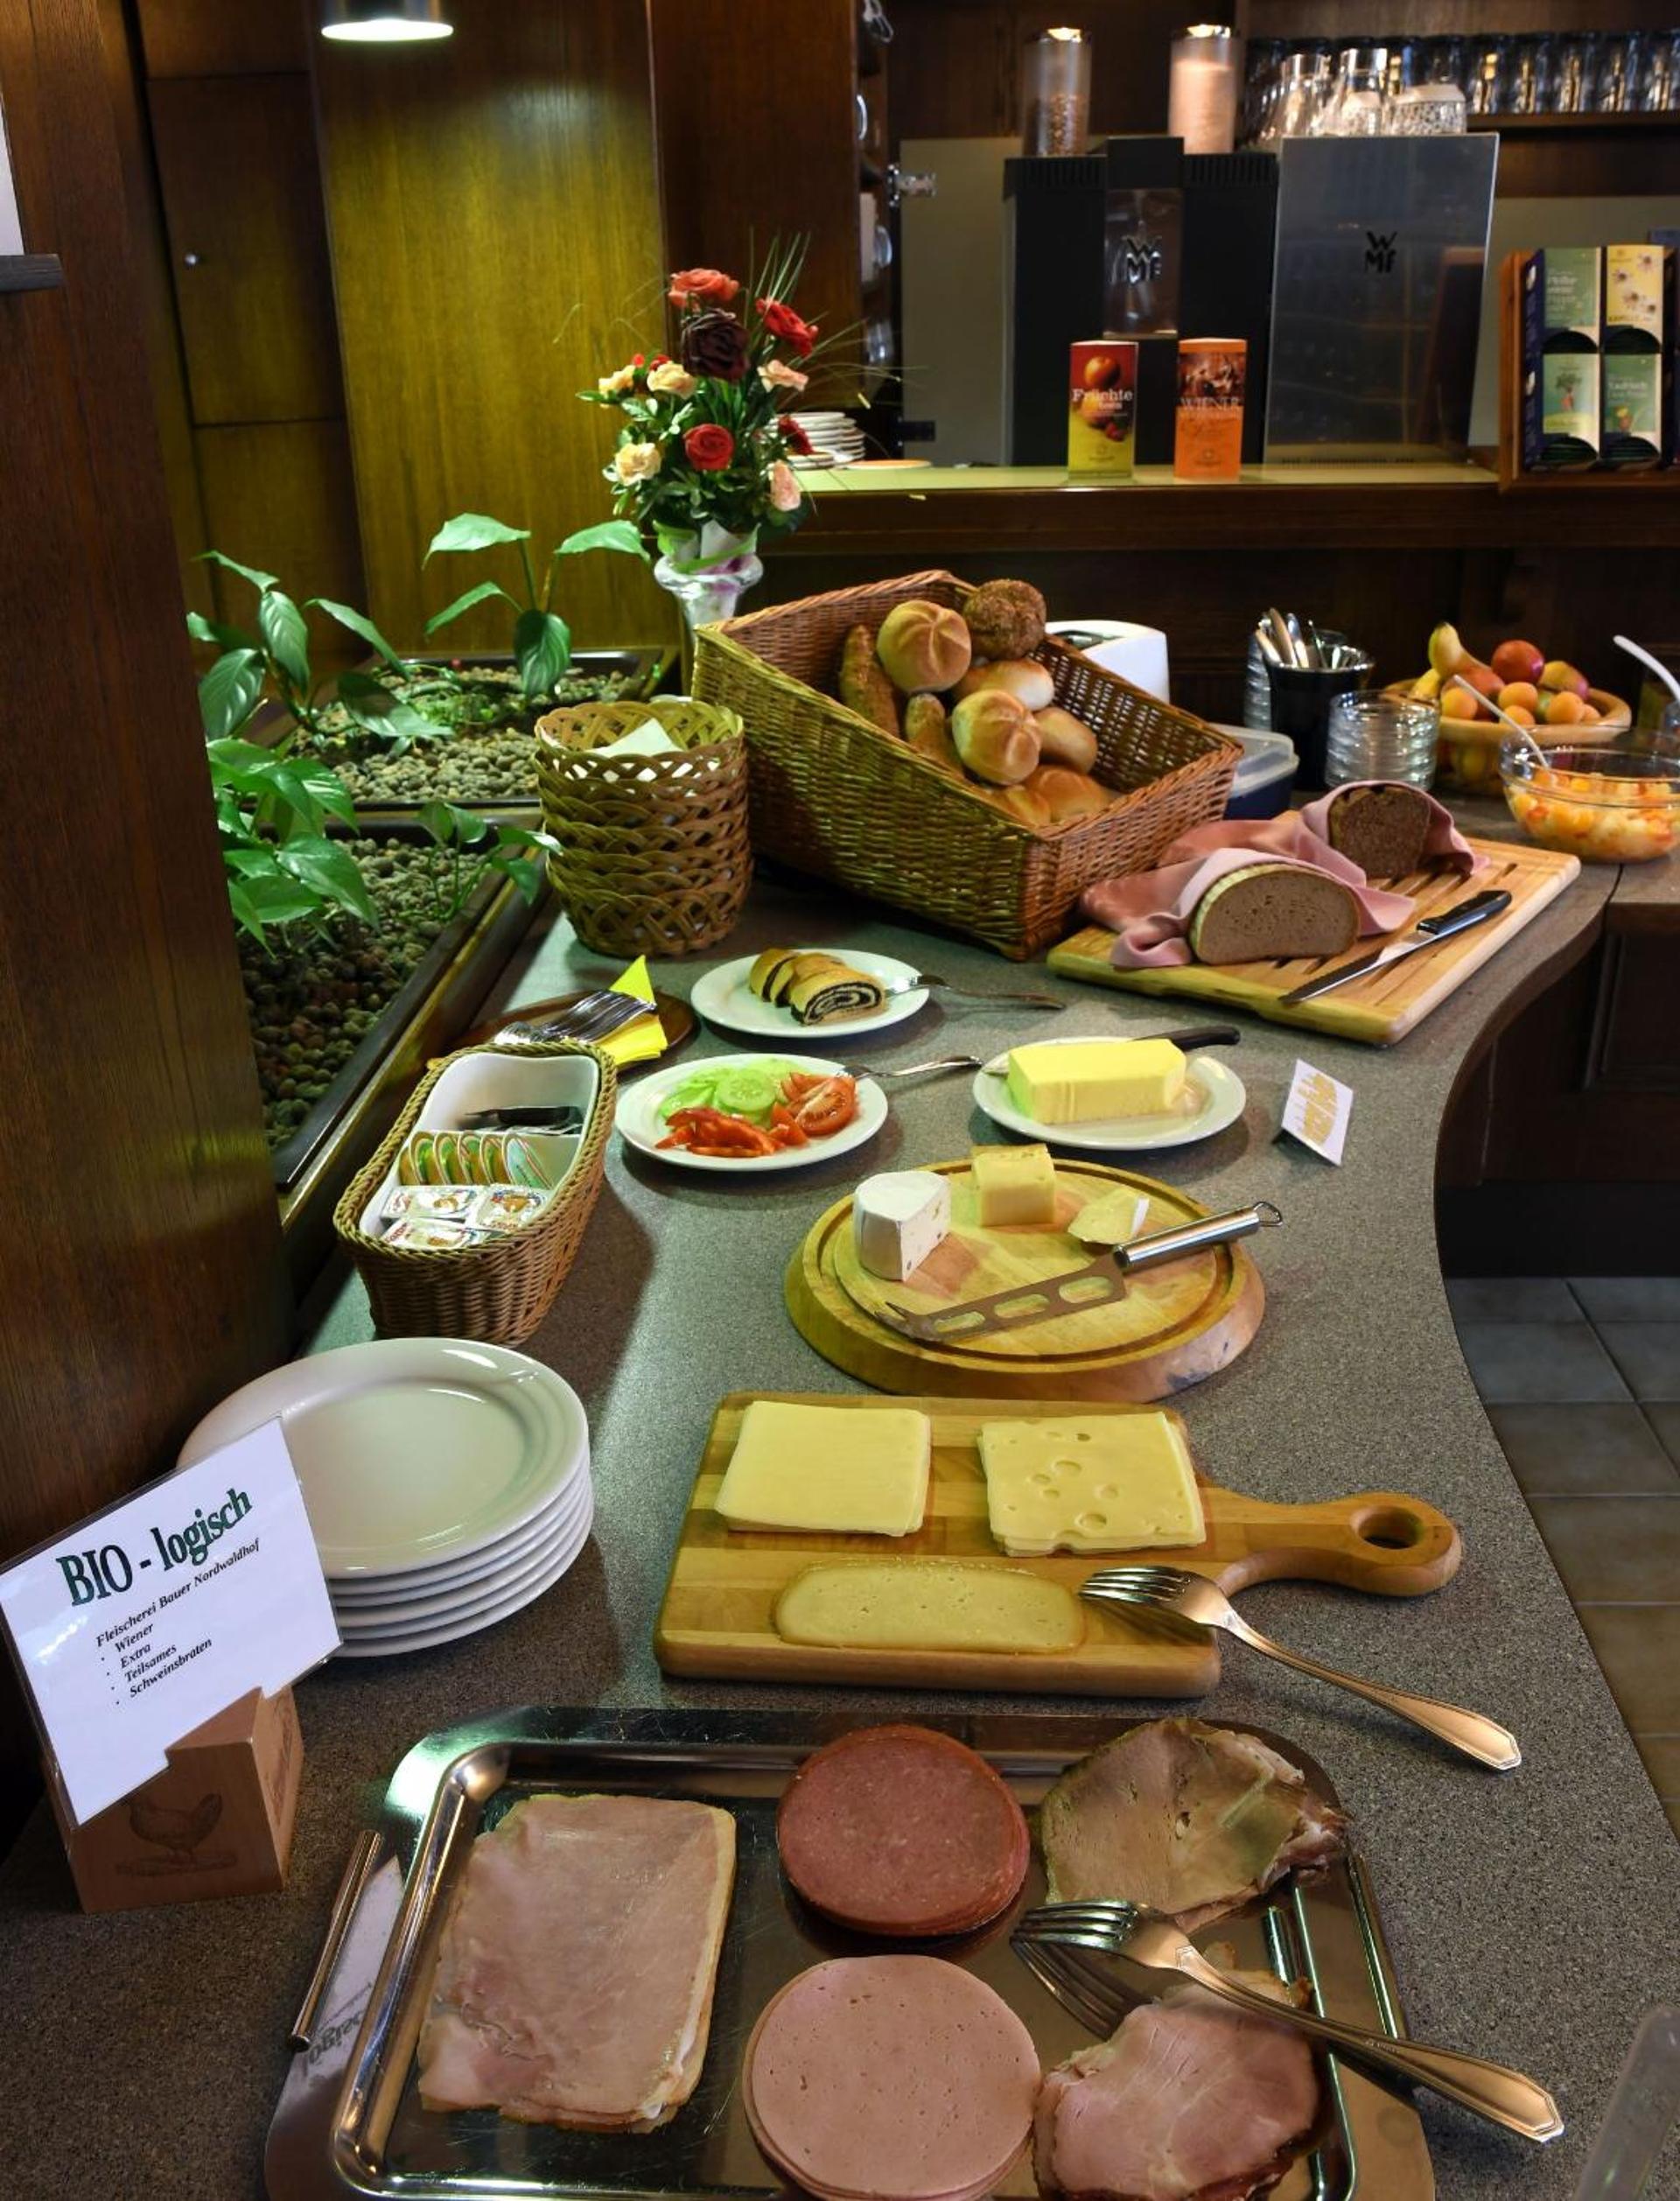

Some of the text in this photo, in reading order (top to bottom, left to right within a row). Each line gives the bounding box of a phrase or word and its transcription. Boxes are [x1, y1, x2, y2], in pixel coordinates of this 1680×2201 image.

[55, 1544, 133, 1607] BIO
[150, 1488, 253, 1572] logisch
[96, 1538, 259, 1647] Fleischerei Bauer Nordwaldhof
[114, 1623, 153, 1652] Wiener
[120, 1644, 150, 1668] Extra
[124, 1644, 177, 1683] Teilsames
[130, 1638, 212, 1698] Schweinsbraten
